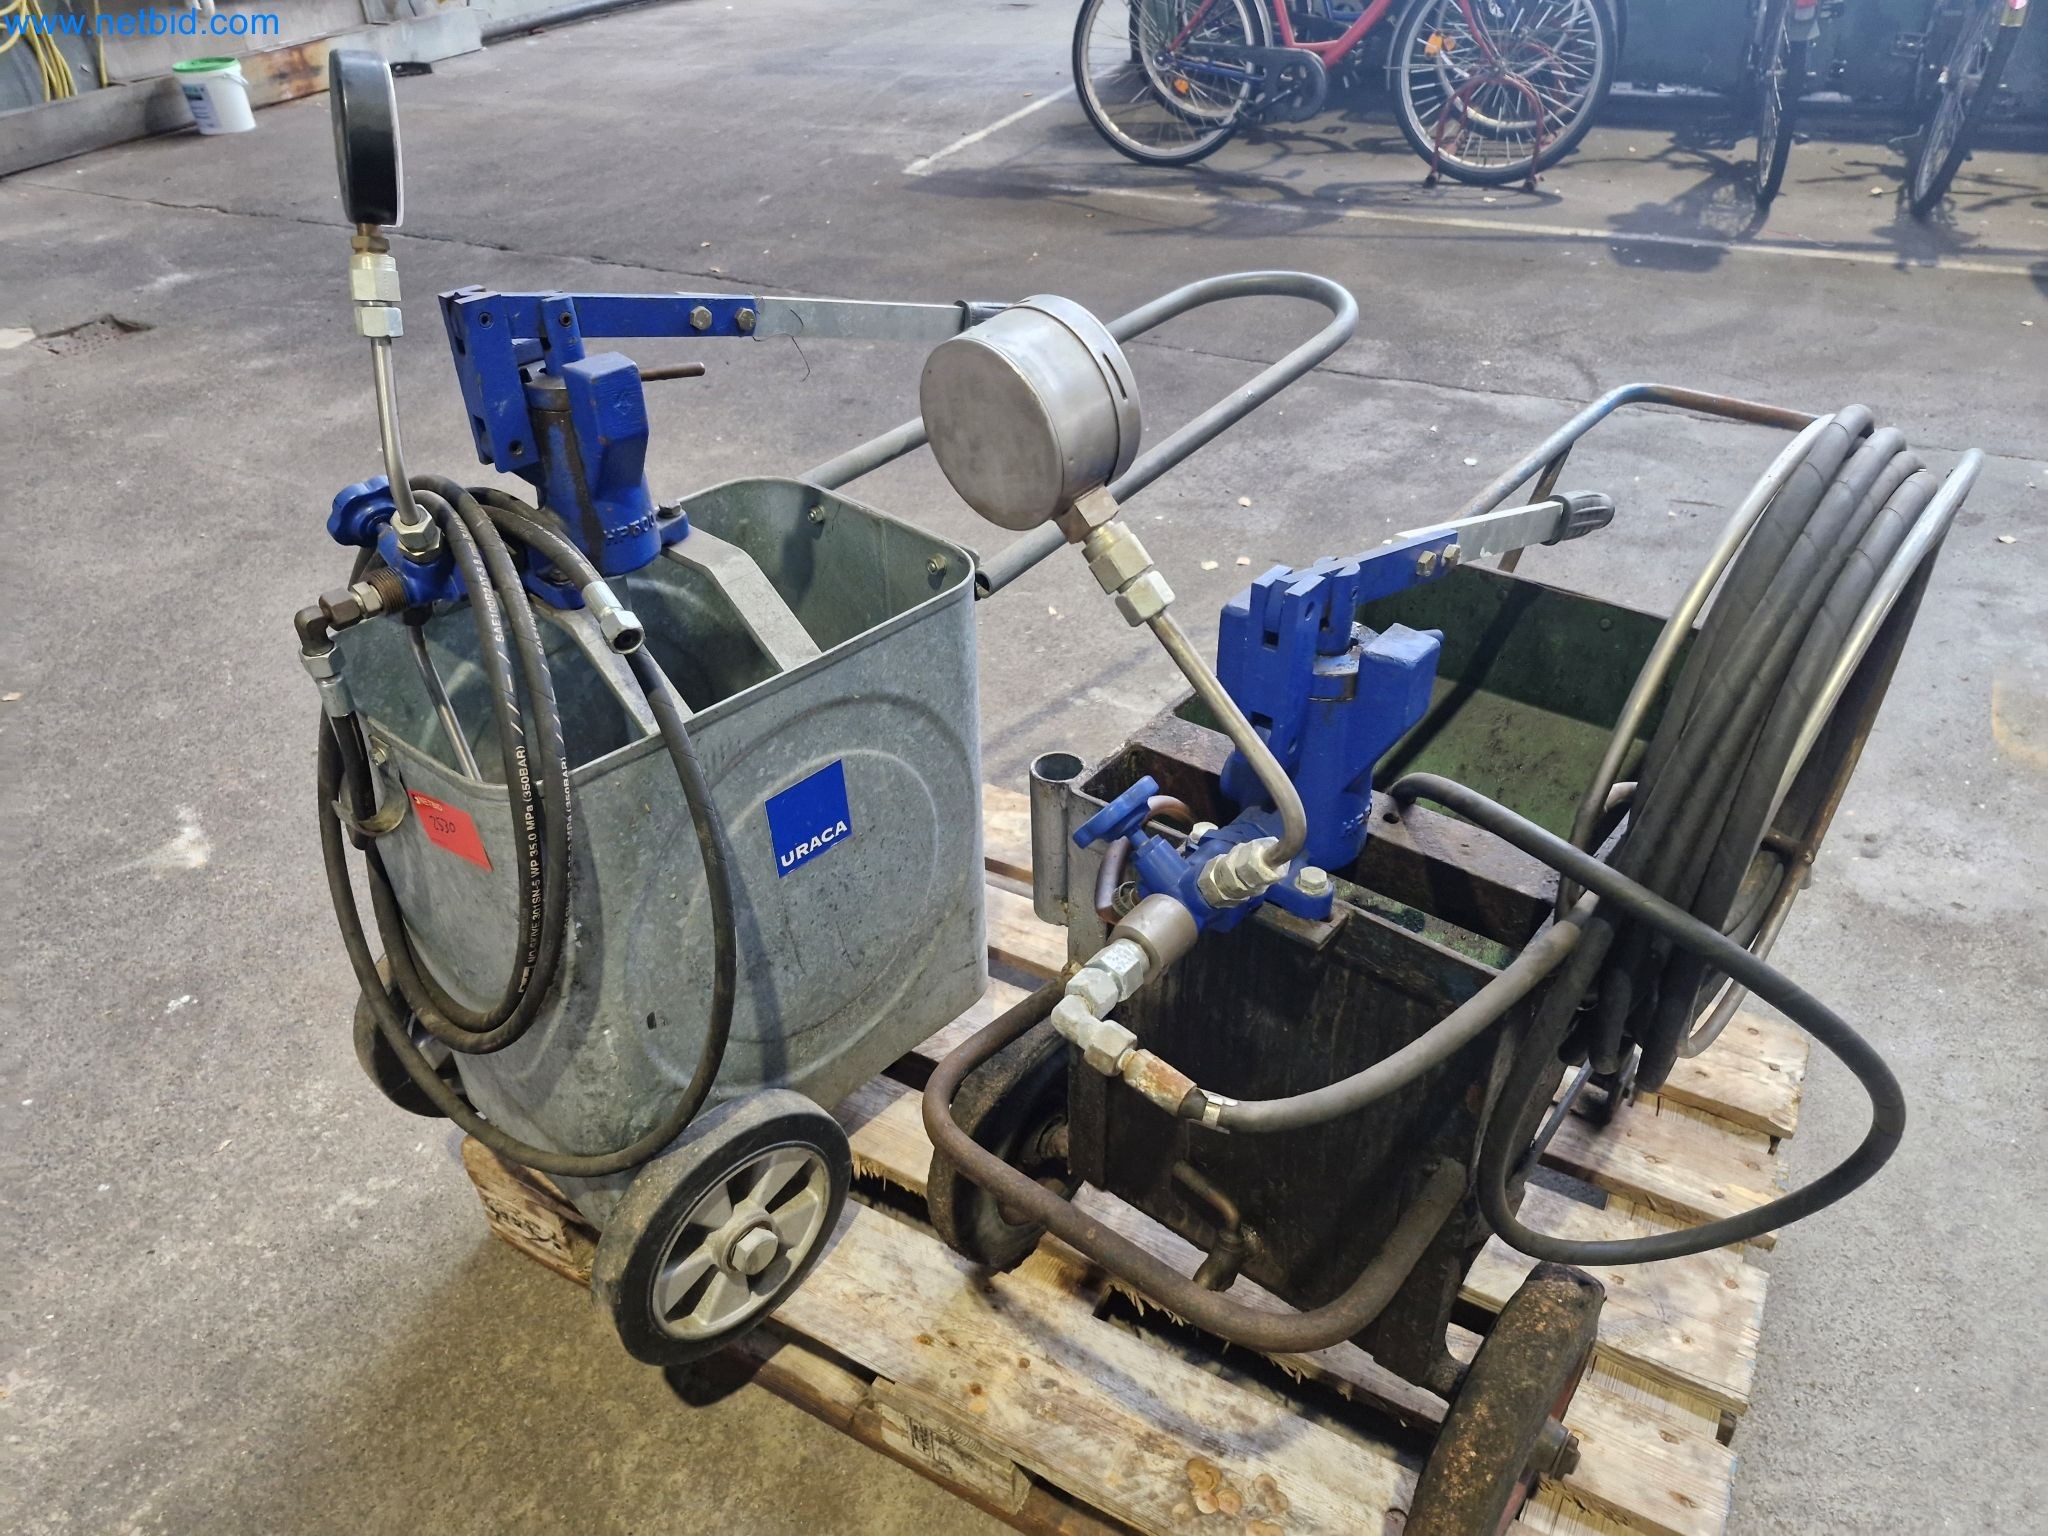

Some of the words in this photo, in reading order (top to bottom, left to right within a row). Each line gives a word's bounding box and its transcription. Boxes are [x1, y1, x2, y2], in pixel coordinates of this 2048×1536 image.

[515, 745, 532, 802] (350BAR)
[525, 804, 536, 831] MPa
[528, 833, 539, 857] 35.0
[781, 820, 848, 867] URACA
[530, 860, 541, 879] WP
[531, 879, 541, 921] 301SN-5
